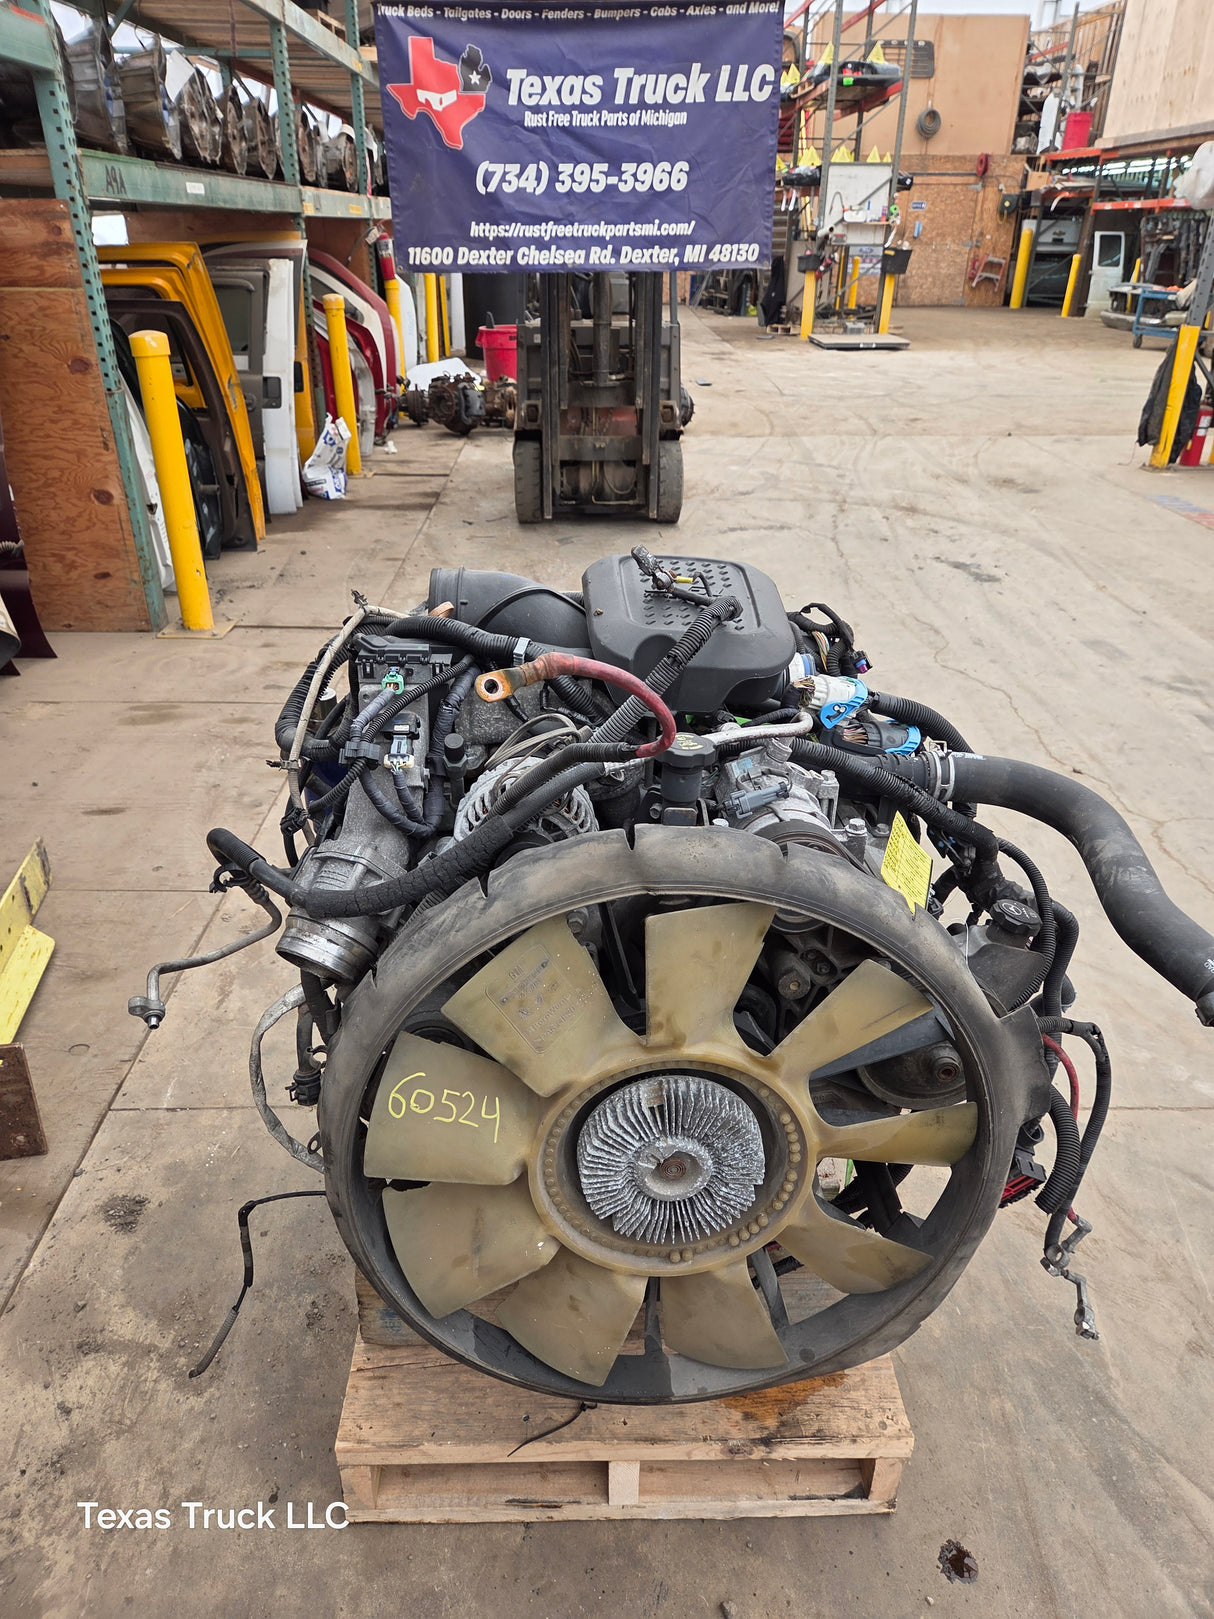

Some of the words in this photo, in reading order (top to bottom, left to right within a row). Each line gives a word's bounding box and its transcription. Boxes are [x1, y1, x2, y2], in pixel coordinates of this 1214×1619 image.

[377, 3, 404, 16] Truck
[407, 6, 433, 18] Beds
[444, 7, 491, 21] Tailgates
[501, 9, 532, 19] Doors
[542, 9, 584, 19] Fenders
[594, 9, 640, 20] Bumpers
[650, 6, 677, 16] Cabs
[686, 4, 716, 15] Axles
[726, 3, 747, 14] and
[749, 1, 779, 13] More!
[506, 68, 603, 106] Texas
[613, 63, 711, 104] Truck
[715, 64, 775, 103] LLC
[524, 111, 547, 127] Rust
[548, 111, 570, 127] Free
[572, 111, 599, 126] Truck
[601, 110, 628, 126] Parts
[629, 109, 640, 126] of
[642, 109, 687, 128] Michigan
[476, 161, 549, 196] (734)
[556, 162, 689, 193] 395-3966
[470, 220, 695, 239] https://rustfreetruckpartsmi.com/
[408, 246, 454, 265] 11600
[458, 246, 514, 265] Dexter
[517, 245, 587, 265] Chelsea
[590, 244, 616, 264] Rd.
[620, 245, 679, 265] Dexter,
[683, 244, 706, 263] MI
[709, 243, 759, 263] 48130
[388, 1071, 500, 1143] 60524
